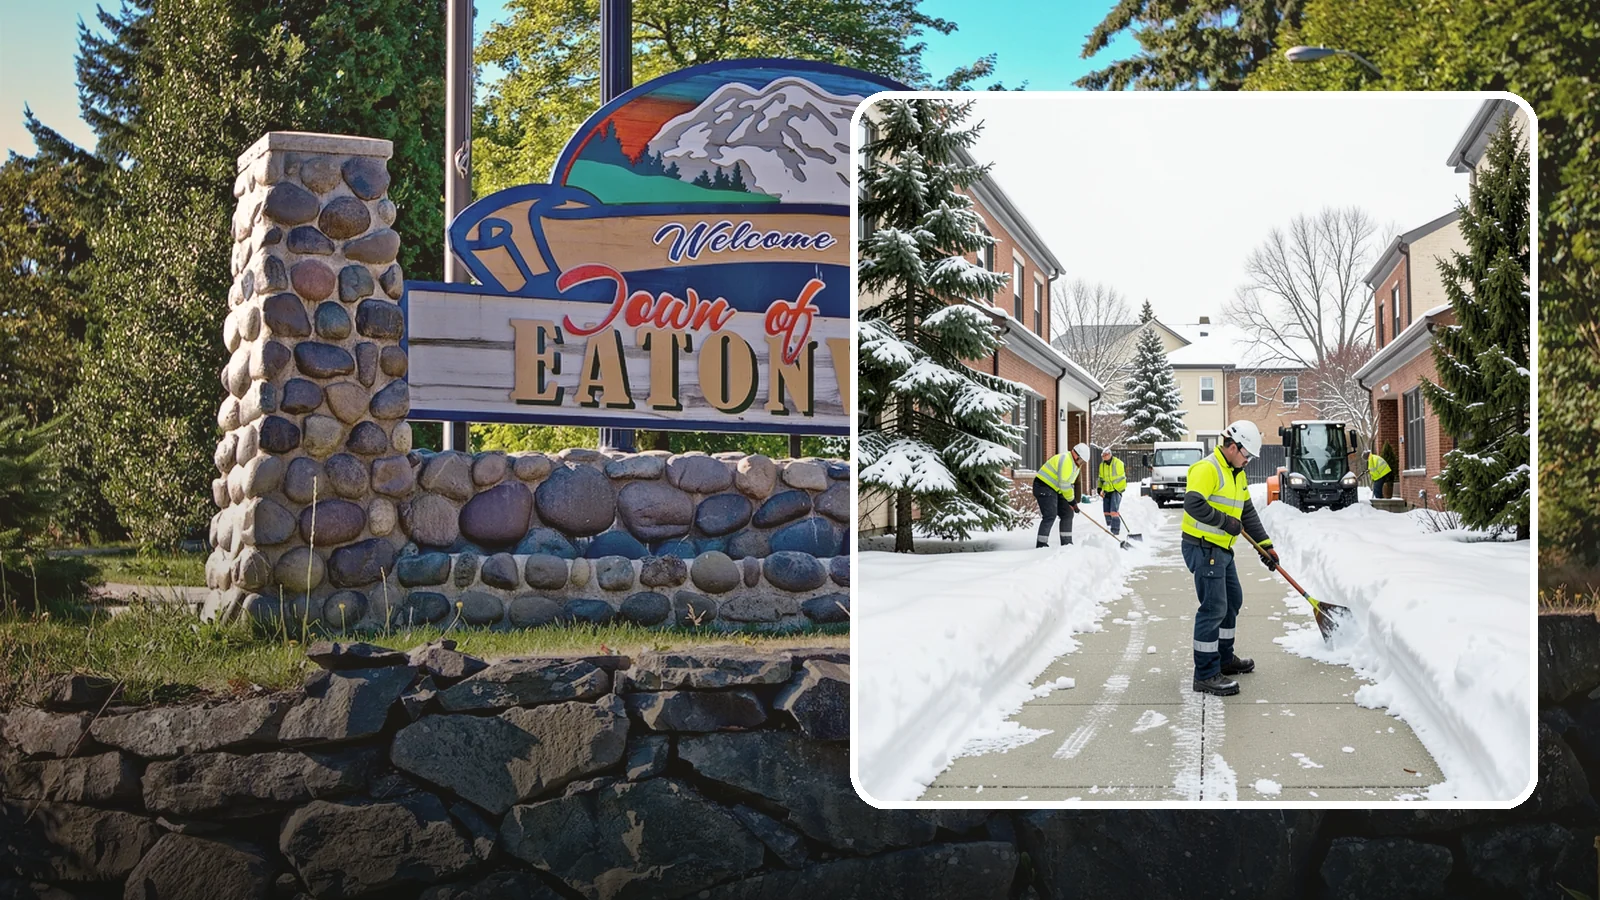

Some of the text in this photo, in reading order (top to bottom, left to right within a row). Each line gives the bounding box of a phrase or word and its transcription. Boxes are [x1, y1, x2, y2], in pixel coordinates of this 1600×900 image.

[653, 221, 837, 263] Welcome
[557, 263, 826, 366] Town of
